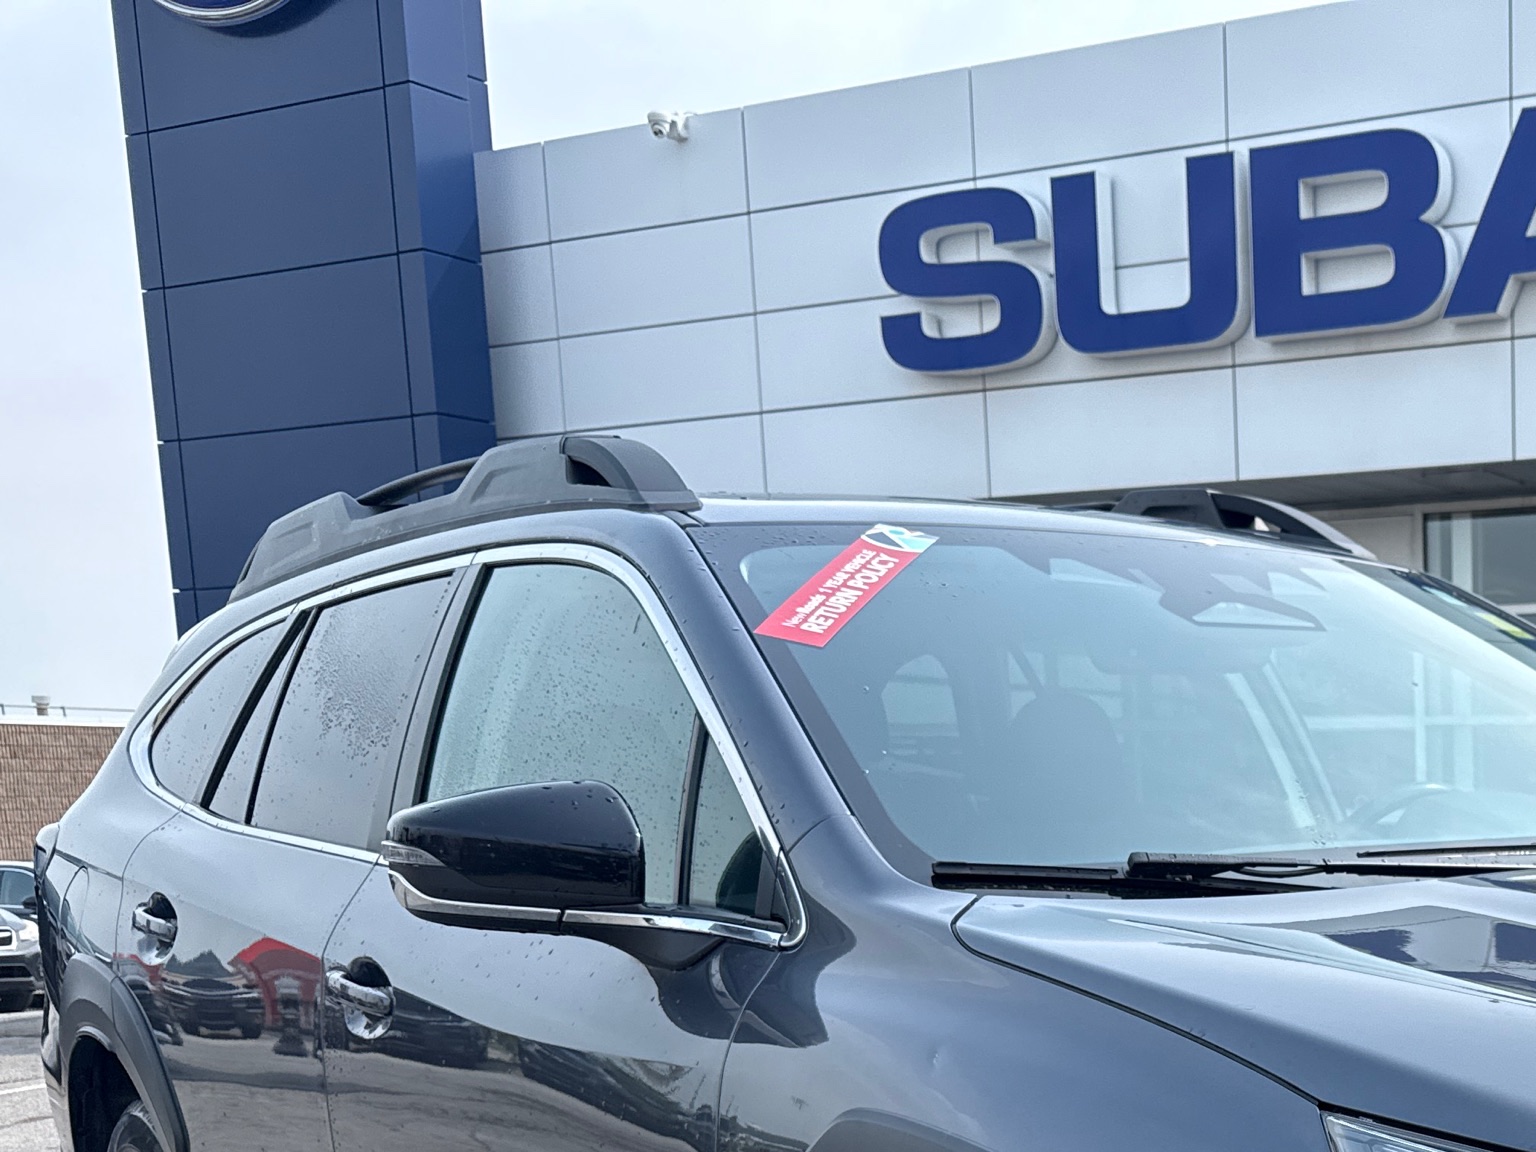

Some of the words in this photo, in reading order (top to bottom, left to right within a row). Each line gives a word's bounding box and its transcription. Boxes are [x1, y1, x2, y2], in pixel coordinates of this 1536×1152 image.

[800, 587, 863, 634] RETURN
[847, 552, 900, 590] POLICY
[823, 571, 851, 588] YEAR
[841, 549, 877, 573] VEHICLE
